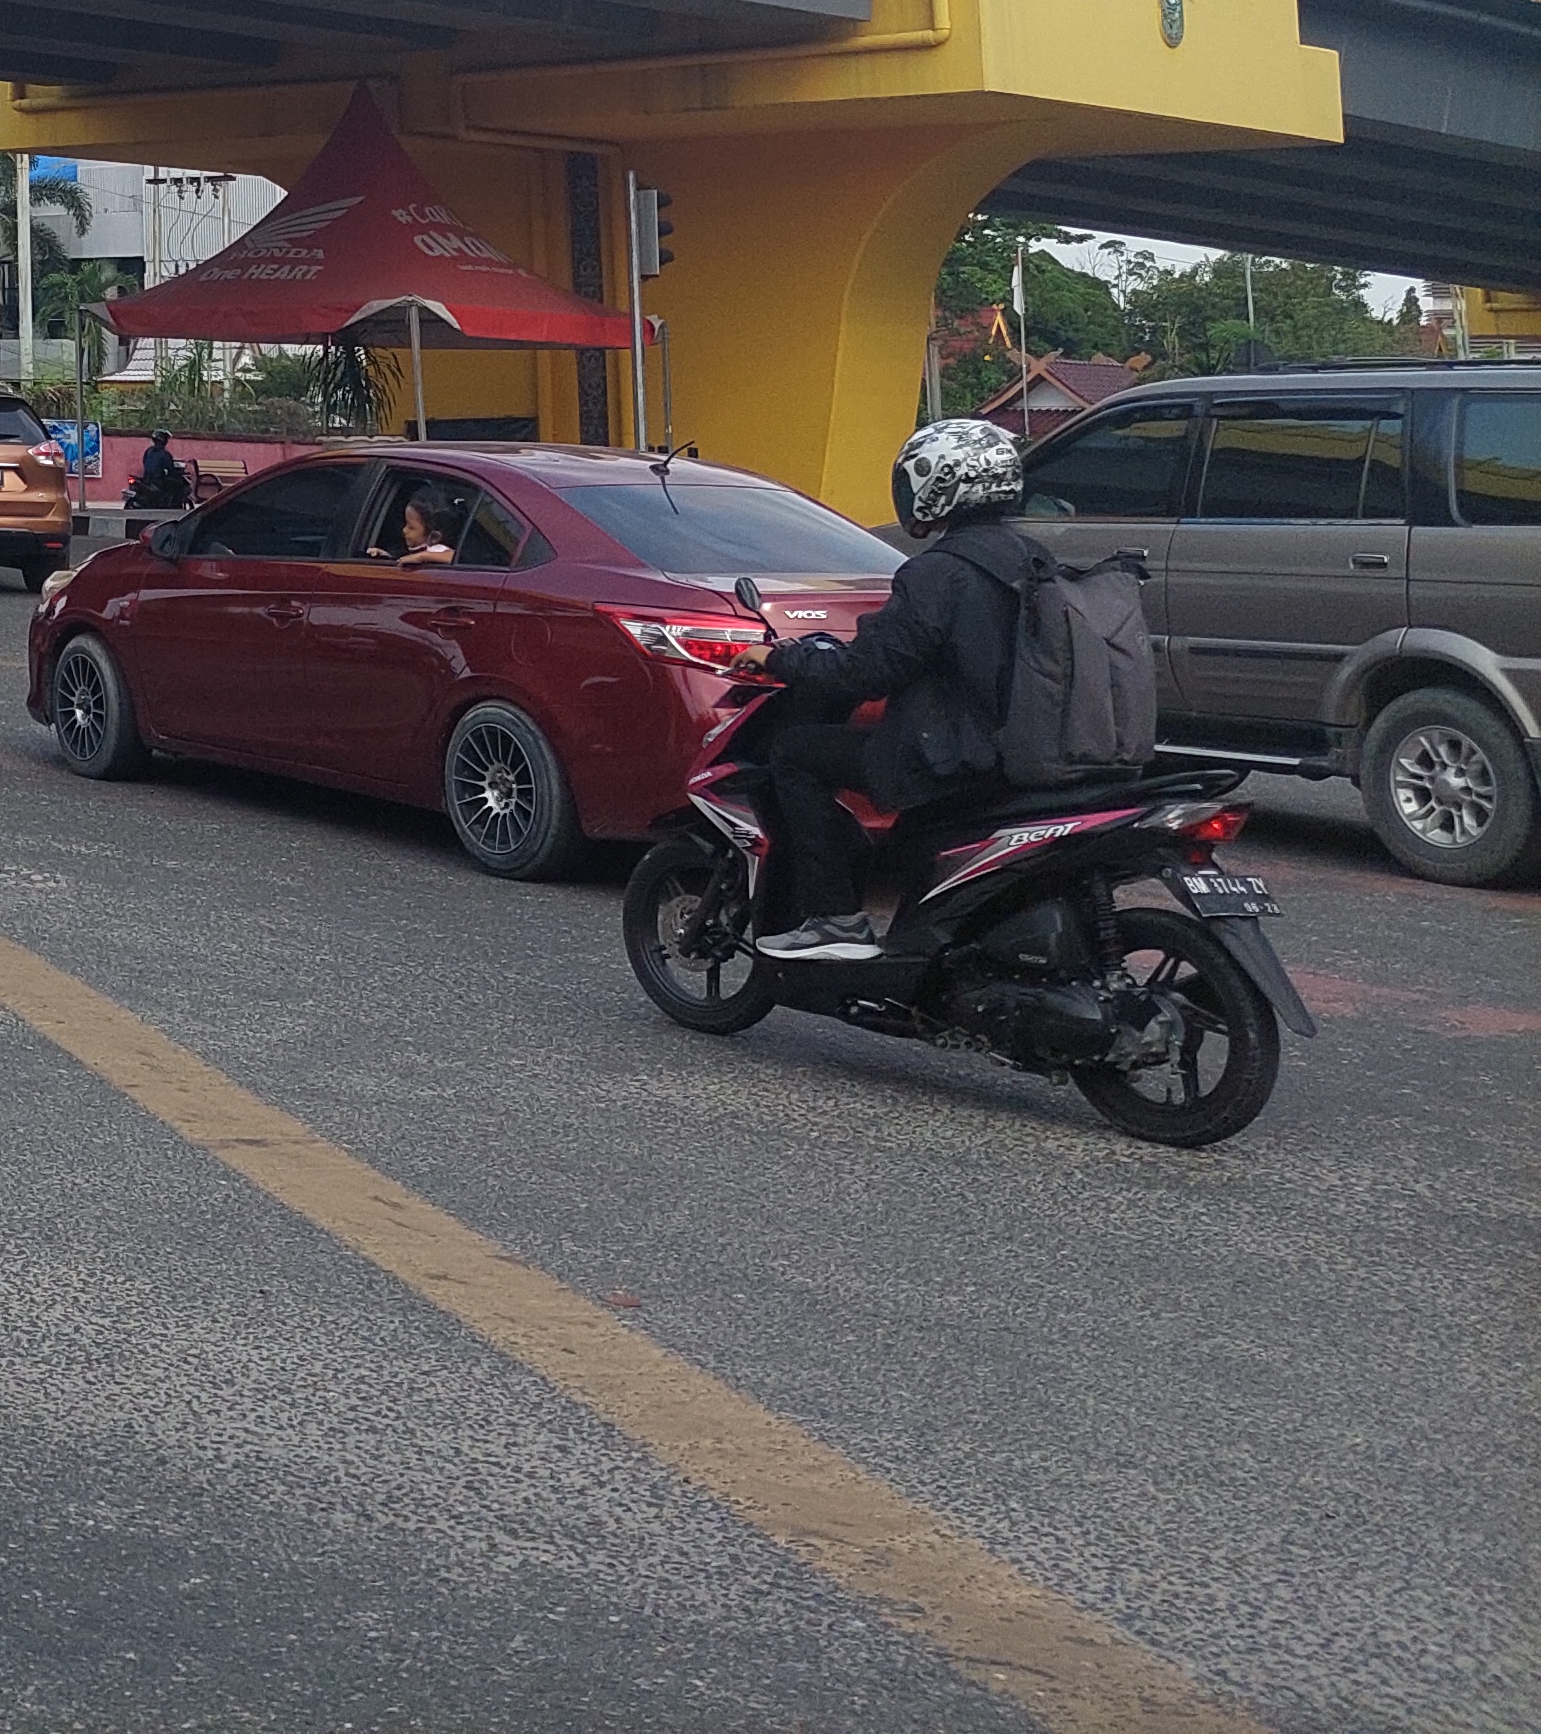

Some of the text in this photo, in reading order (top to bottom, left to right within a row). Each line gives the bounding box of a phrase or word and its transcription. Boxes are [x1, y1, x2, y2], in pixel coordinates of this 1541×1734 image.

[228, 248, 325, 262] HONDA
[783, 610, 828, 619] VIOS
[1183, 876, 1269, 895] BM 3744 ZY
